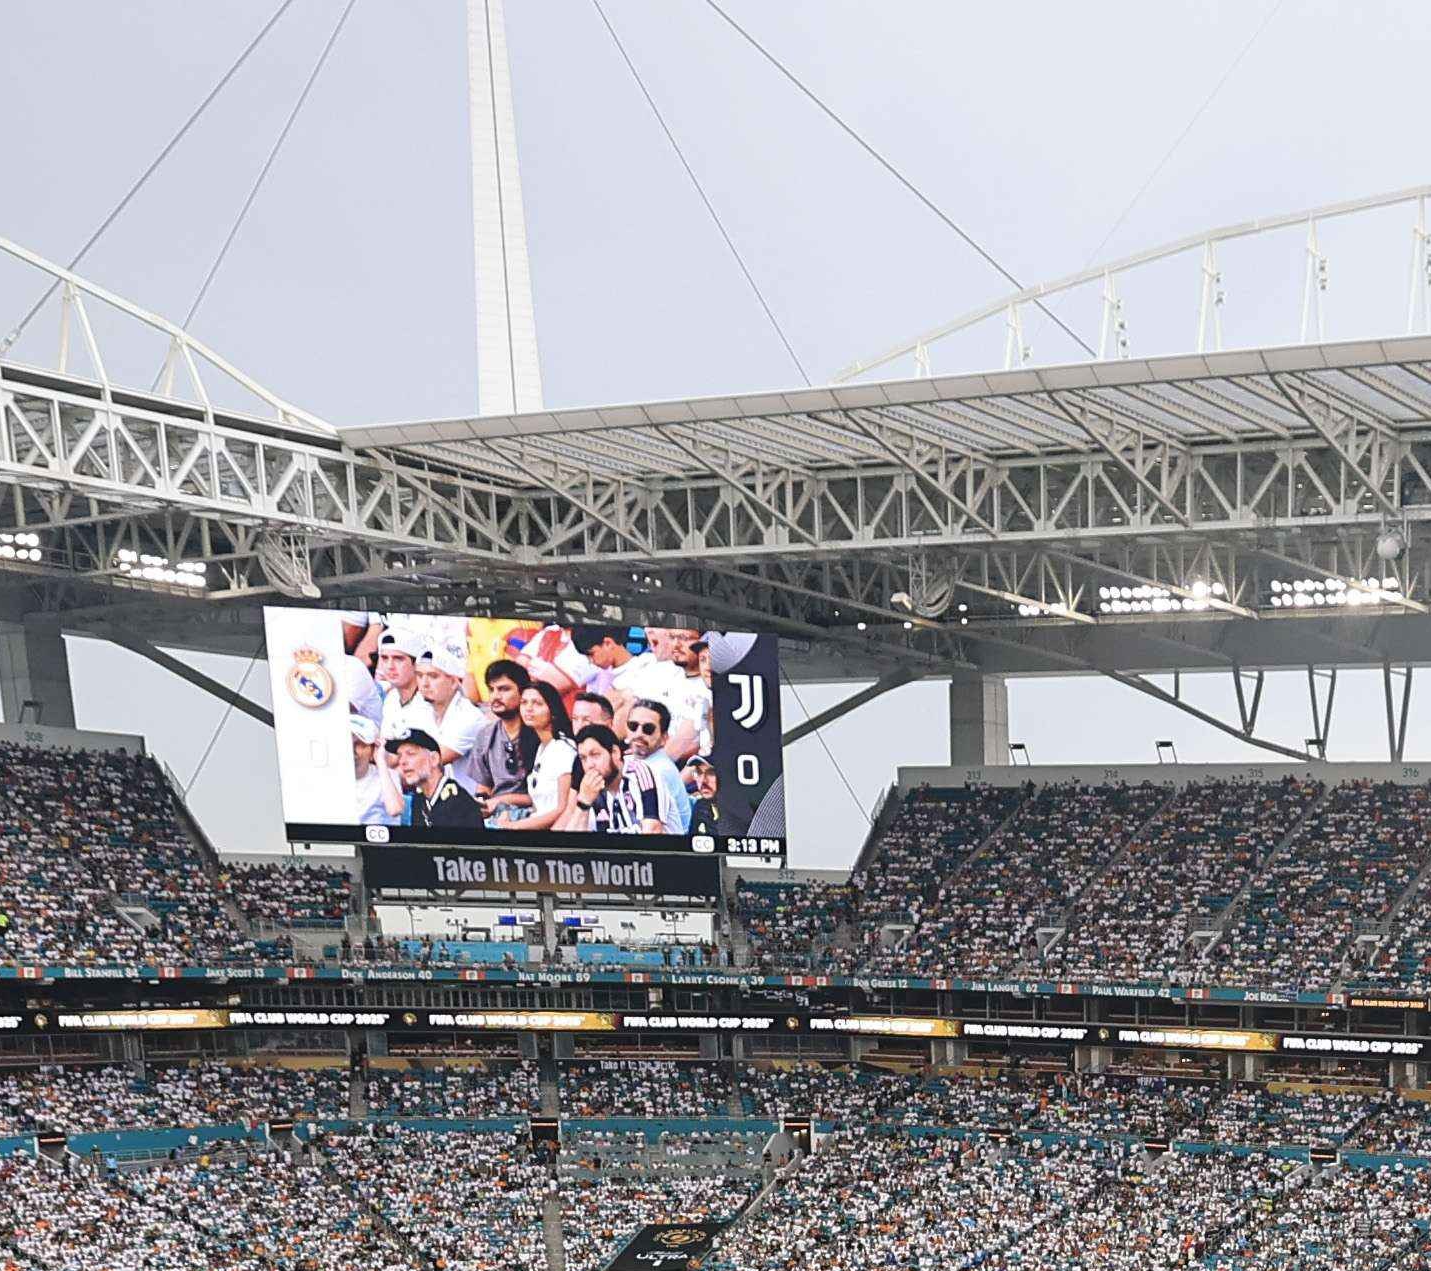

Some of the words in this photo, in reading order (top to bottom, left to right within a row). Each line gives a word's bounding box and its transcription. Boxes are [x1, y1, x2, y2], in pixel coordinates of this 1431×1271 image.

[737, 754, 760, 786] 0
[1402, 767, 1420, 778] 316
[727, 838, 757, 852] 3:13
[760, 840, 780, 854] PM
[433, 856, 486, 882] Take
[492, 857, 509, 883] It
[514, 858, 539, 883] To
[545, 859, 585, 885] The
[588, 860, 654, 887] World
[341, 969, 363, 980] DICK
[367, 970, 416, 981] ANDERSON
[417, 970, 433, 981] 40
[538, 972, 572, 983] MOORE
[575, 972, 591, 983] 89
[671, 974, 703, 986] LARRY
[706, 975, 749, 987] CSONKA
[750, 975, 765, 987] 39
[971, 981, 985, 993] JIM
[986, 982, 1020, 994] LANGER
[1025, 982, 1039, 994] 62
[1092, 985, 1111, 997] PAUL
[1158, 987, 1171, 999] 42
